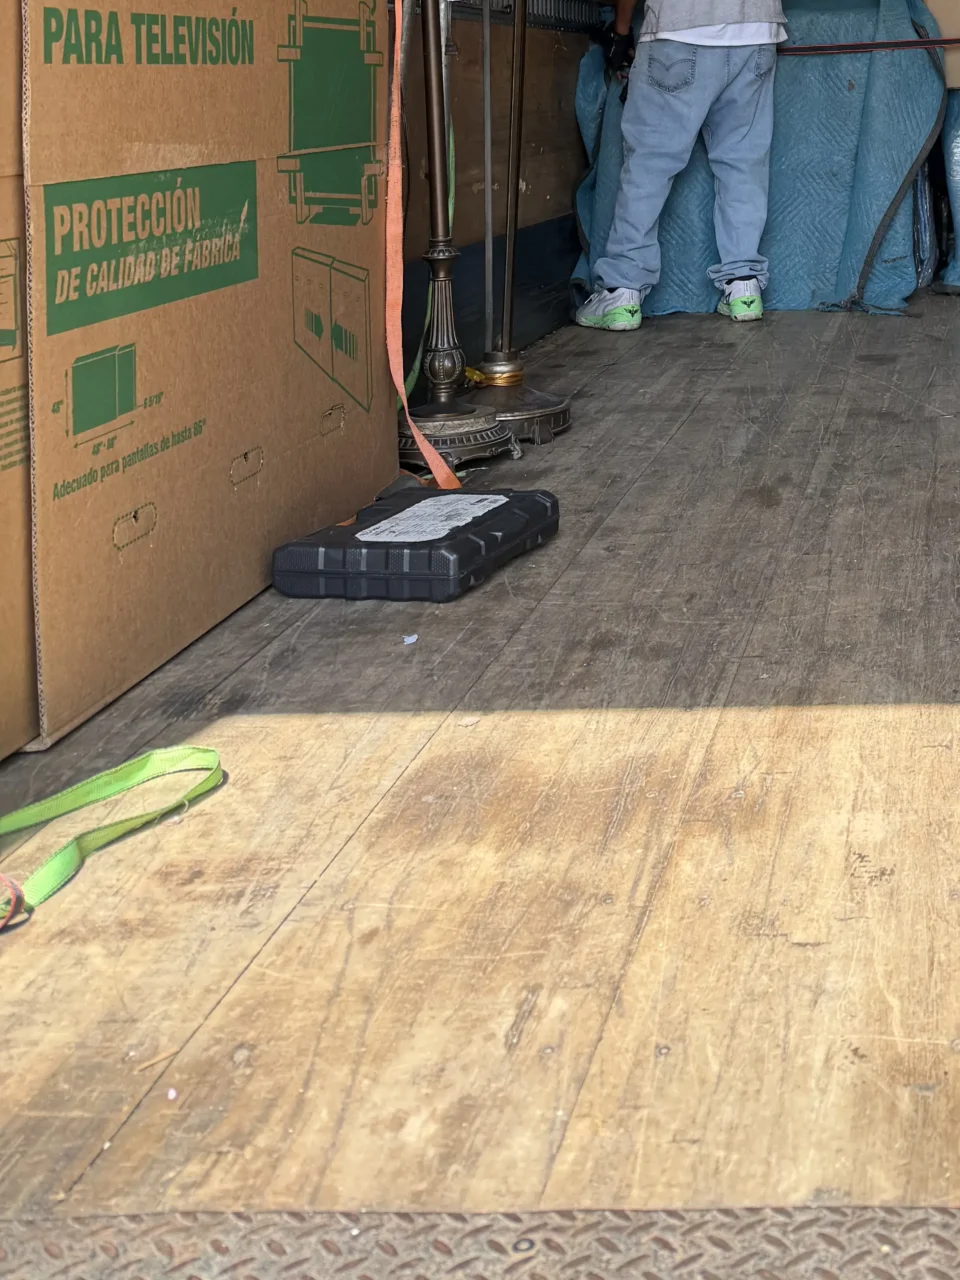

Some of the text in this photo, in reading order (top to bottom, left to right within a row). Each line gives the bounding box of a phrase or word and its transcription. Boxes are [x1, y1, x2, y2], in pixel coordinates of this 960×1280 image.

[43, 6, 255, 65] PARA TELEVISIÓN
[53, 177, 201, 255] PROTECCIÓN
[55, 233, 241, 304] DE CALIDAD DE FÁBRICA
[52, 418, 207, 501] Adecuado para pantallas de hasta 86"
